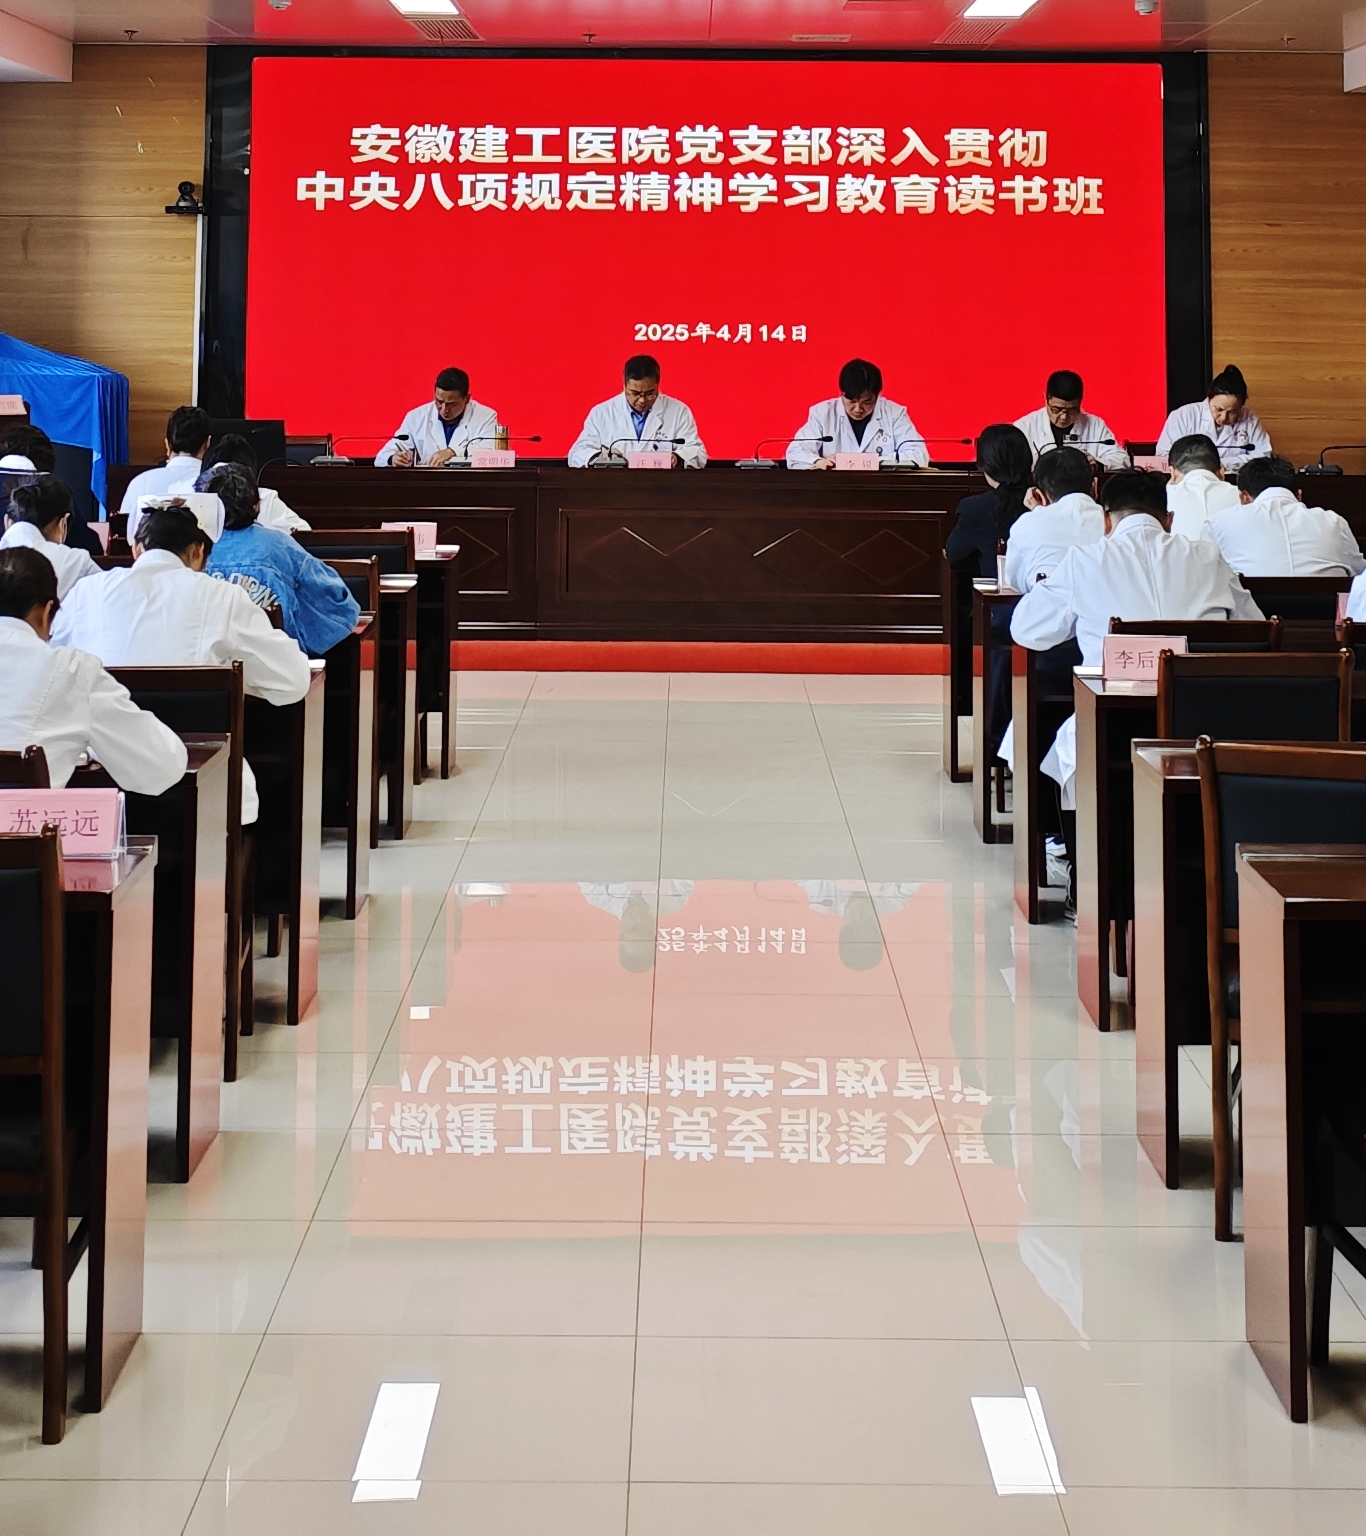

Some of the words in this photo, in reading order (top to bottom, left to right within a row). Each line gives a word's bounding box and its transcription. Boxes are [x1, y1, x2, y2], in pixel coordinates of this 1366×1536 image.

[349, 123, 1049, 167] 安徽建工医院党支部深入贯彻
[295, 169, 1105, 215] 中央八项规定精神学习教育读书班
[633, 321, 808, 344] 2025年4月14日
[1114, 648, 1159, 670] 李后
[8, 808, 100, 837] 苏远远
